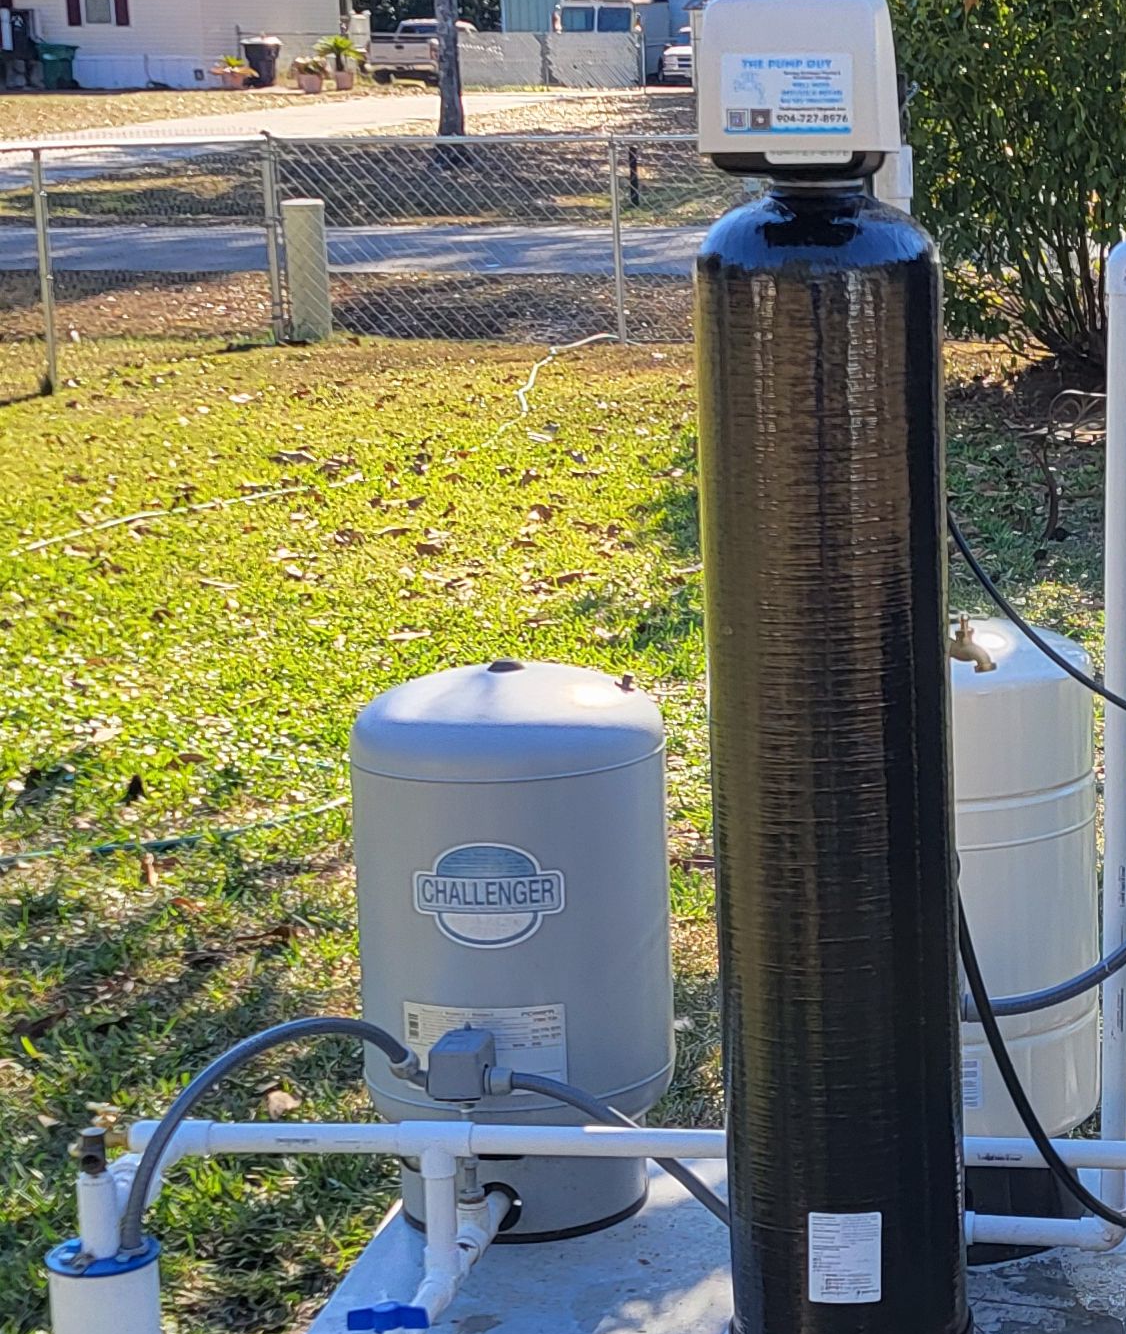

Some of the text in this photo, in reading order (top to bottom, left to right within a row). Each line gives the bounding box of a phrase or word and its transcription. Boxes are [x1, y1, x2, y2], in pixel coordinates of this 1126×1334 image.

[742, 59, 832, 69] THE PUMP GUY
[776, 114, 848, 123] 904-727-8976
[422, 878, 555, 906] CHALLENGER
